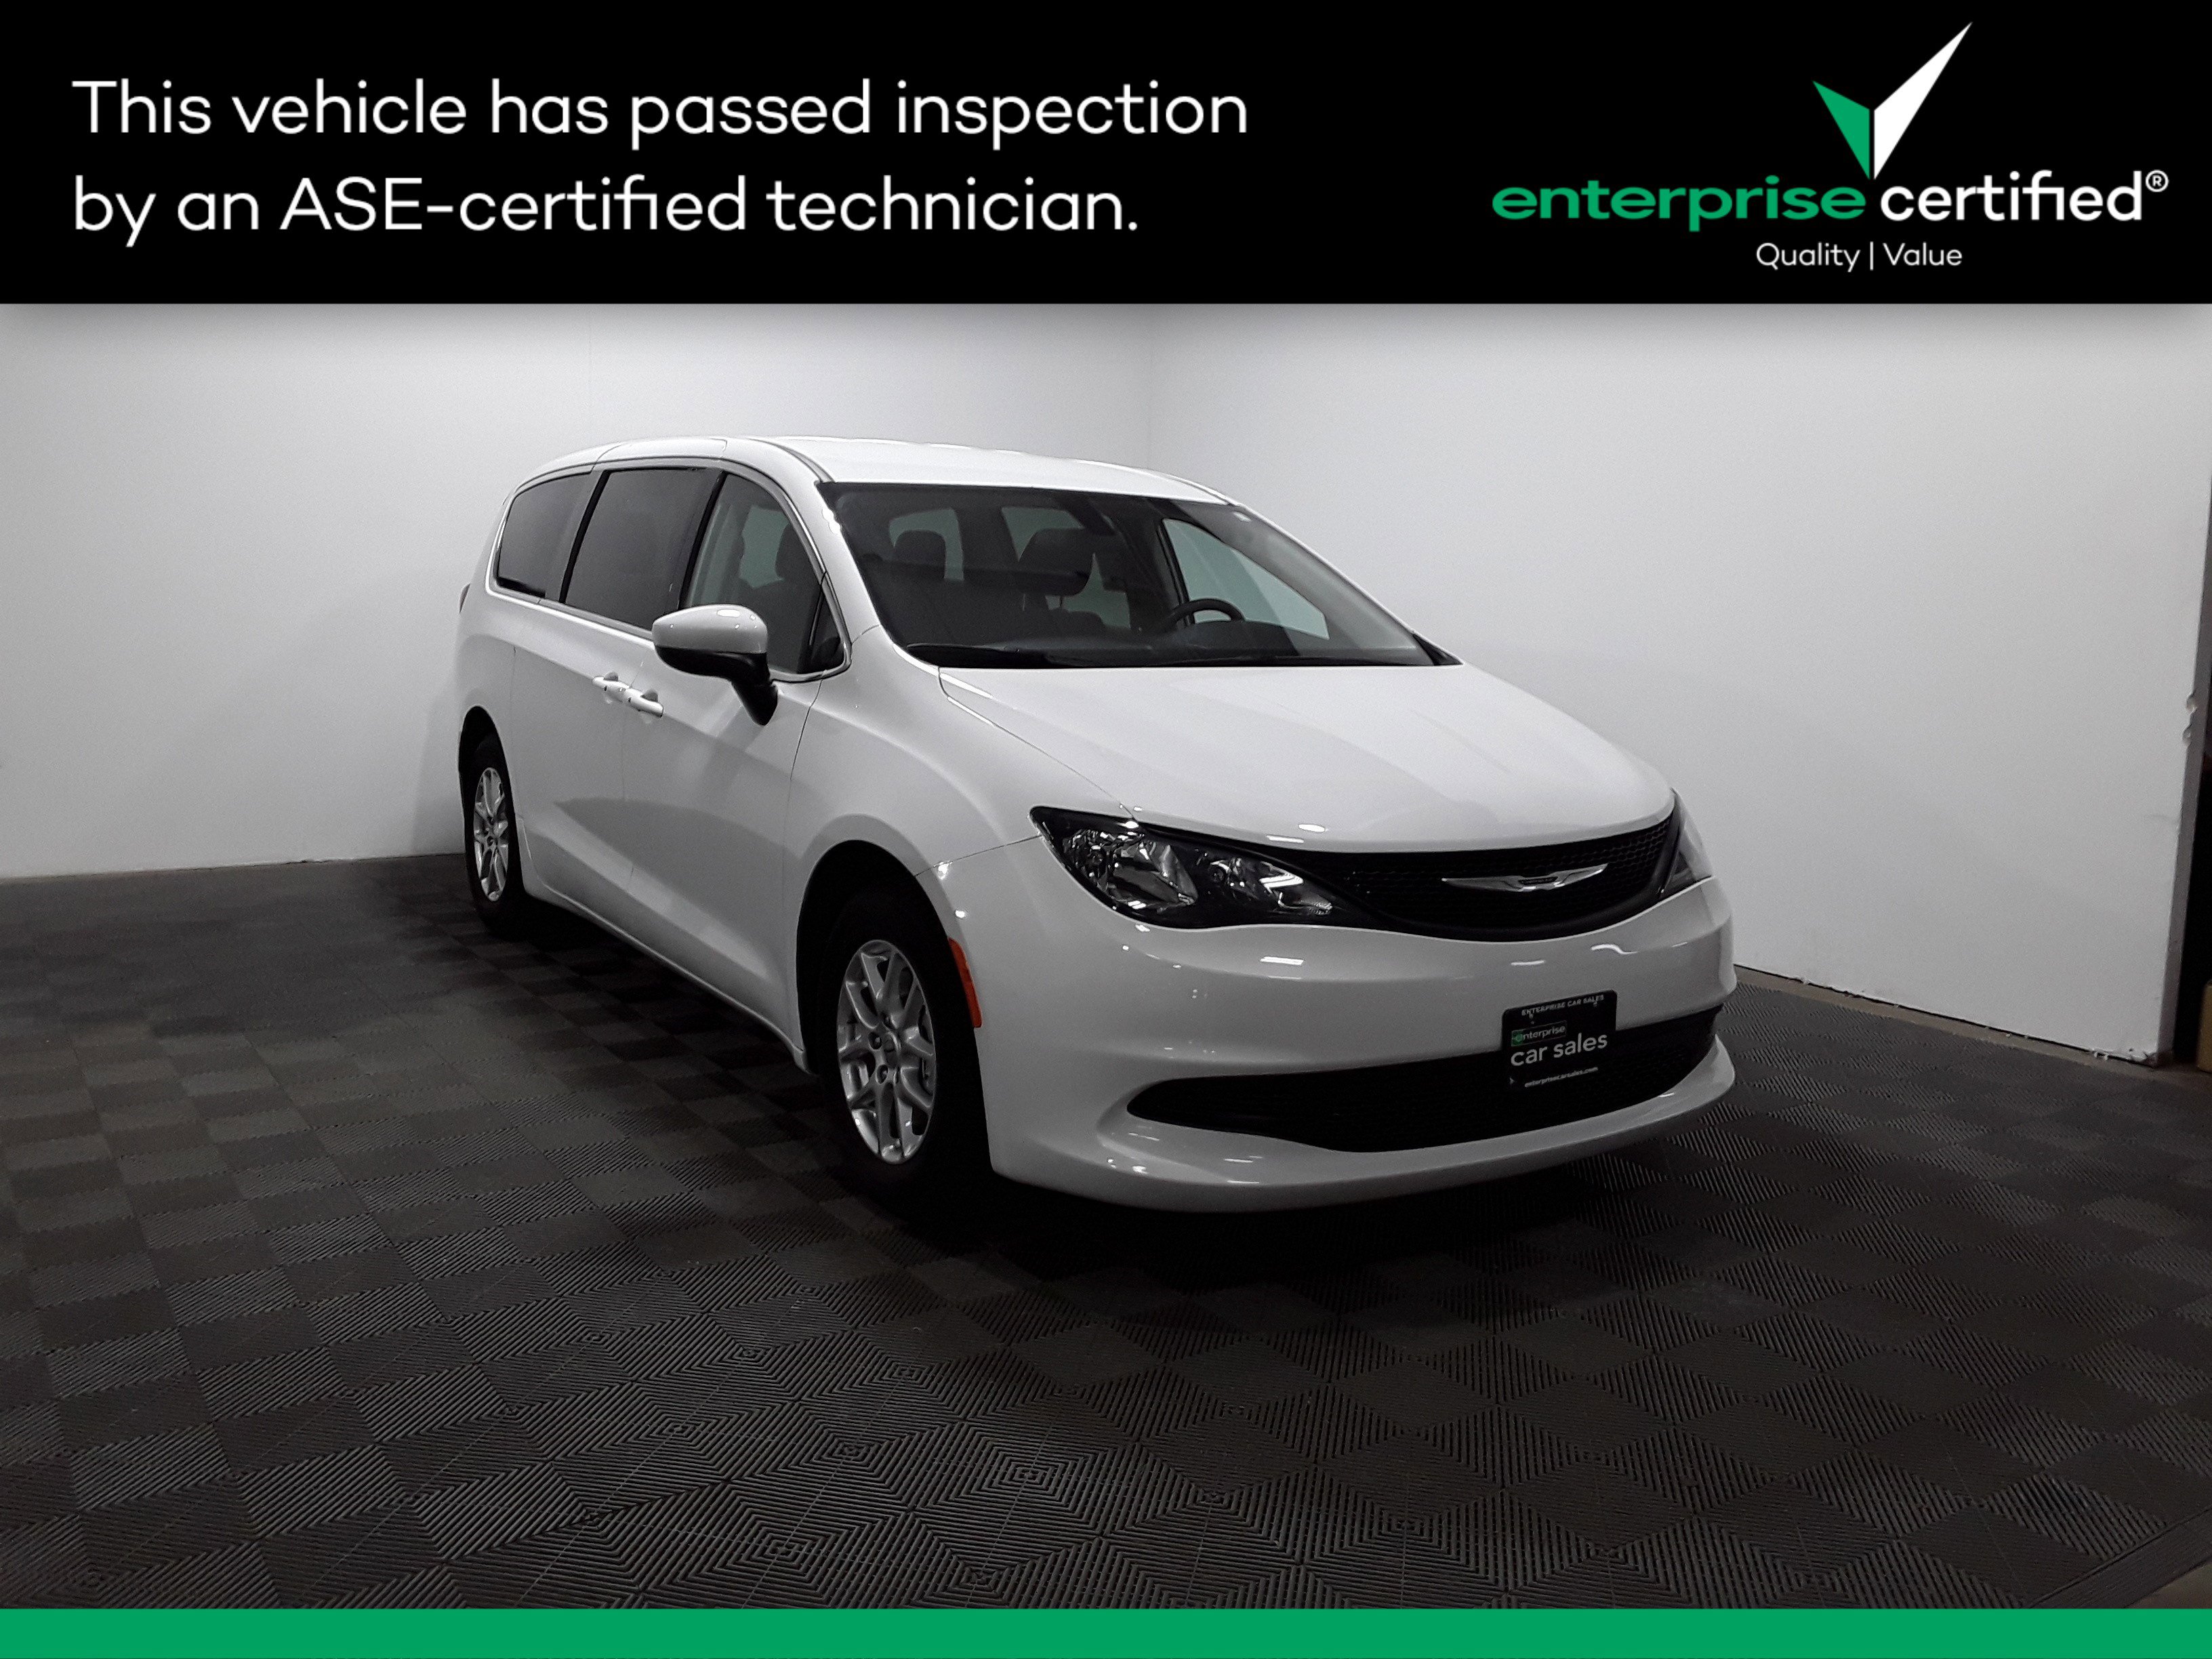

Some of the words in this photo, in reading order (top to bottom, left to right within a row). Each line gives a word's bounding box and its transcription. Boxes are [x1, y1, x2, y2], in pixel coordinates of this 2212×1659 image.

[1521, 1002, 1565, 1016] ENTERPRISE
[1568, 998, 1581, 1007] CAR
[1583, 994, 1604, 1004] SALES
[1512, 1025, 1565, 1043] enterprise
[1511, 1046, 1548, 1066] car
[1553, 1032, 1608, 1059] sales
